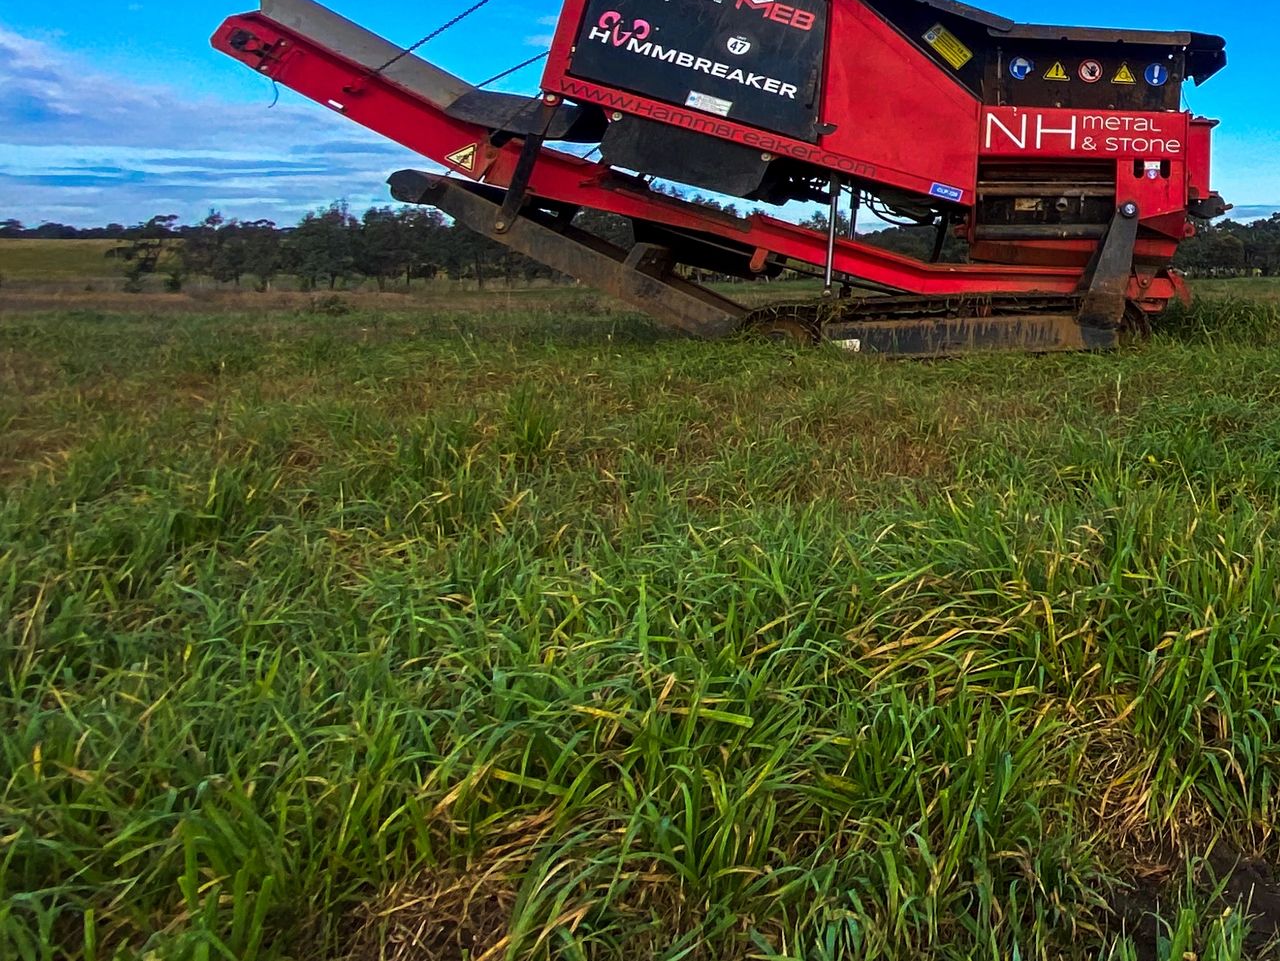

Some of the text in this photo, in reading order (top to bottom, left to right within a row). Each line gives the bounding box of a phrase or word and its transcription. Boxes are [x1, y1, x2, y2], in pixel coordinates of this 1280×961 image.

[729, 41, 747, 53] 47
[985, 112, 1077, 150] NH
[1081, 136, 1097, 151] &
